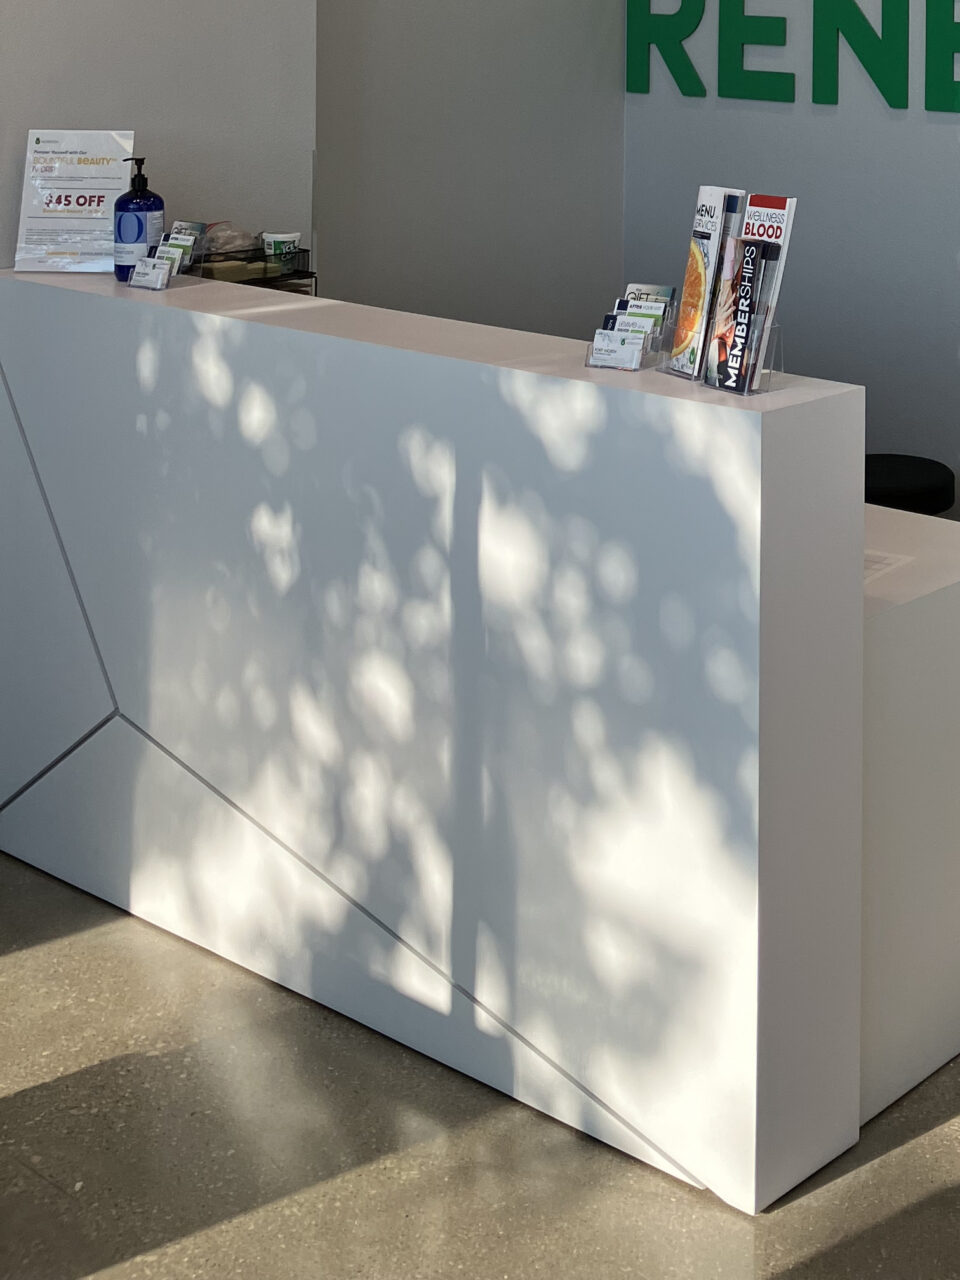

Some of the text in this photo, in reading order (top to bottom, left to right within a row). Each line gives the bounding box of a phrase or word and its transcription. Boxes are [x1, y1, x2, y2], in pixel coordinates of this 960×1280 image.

[76, 195, 105, 207] OFF
[744, 222, 783, 240] BLOOD
[724, 245, 757, 388] MEMBERSHIPS
